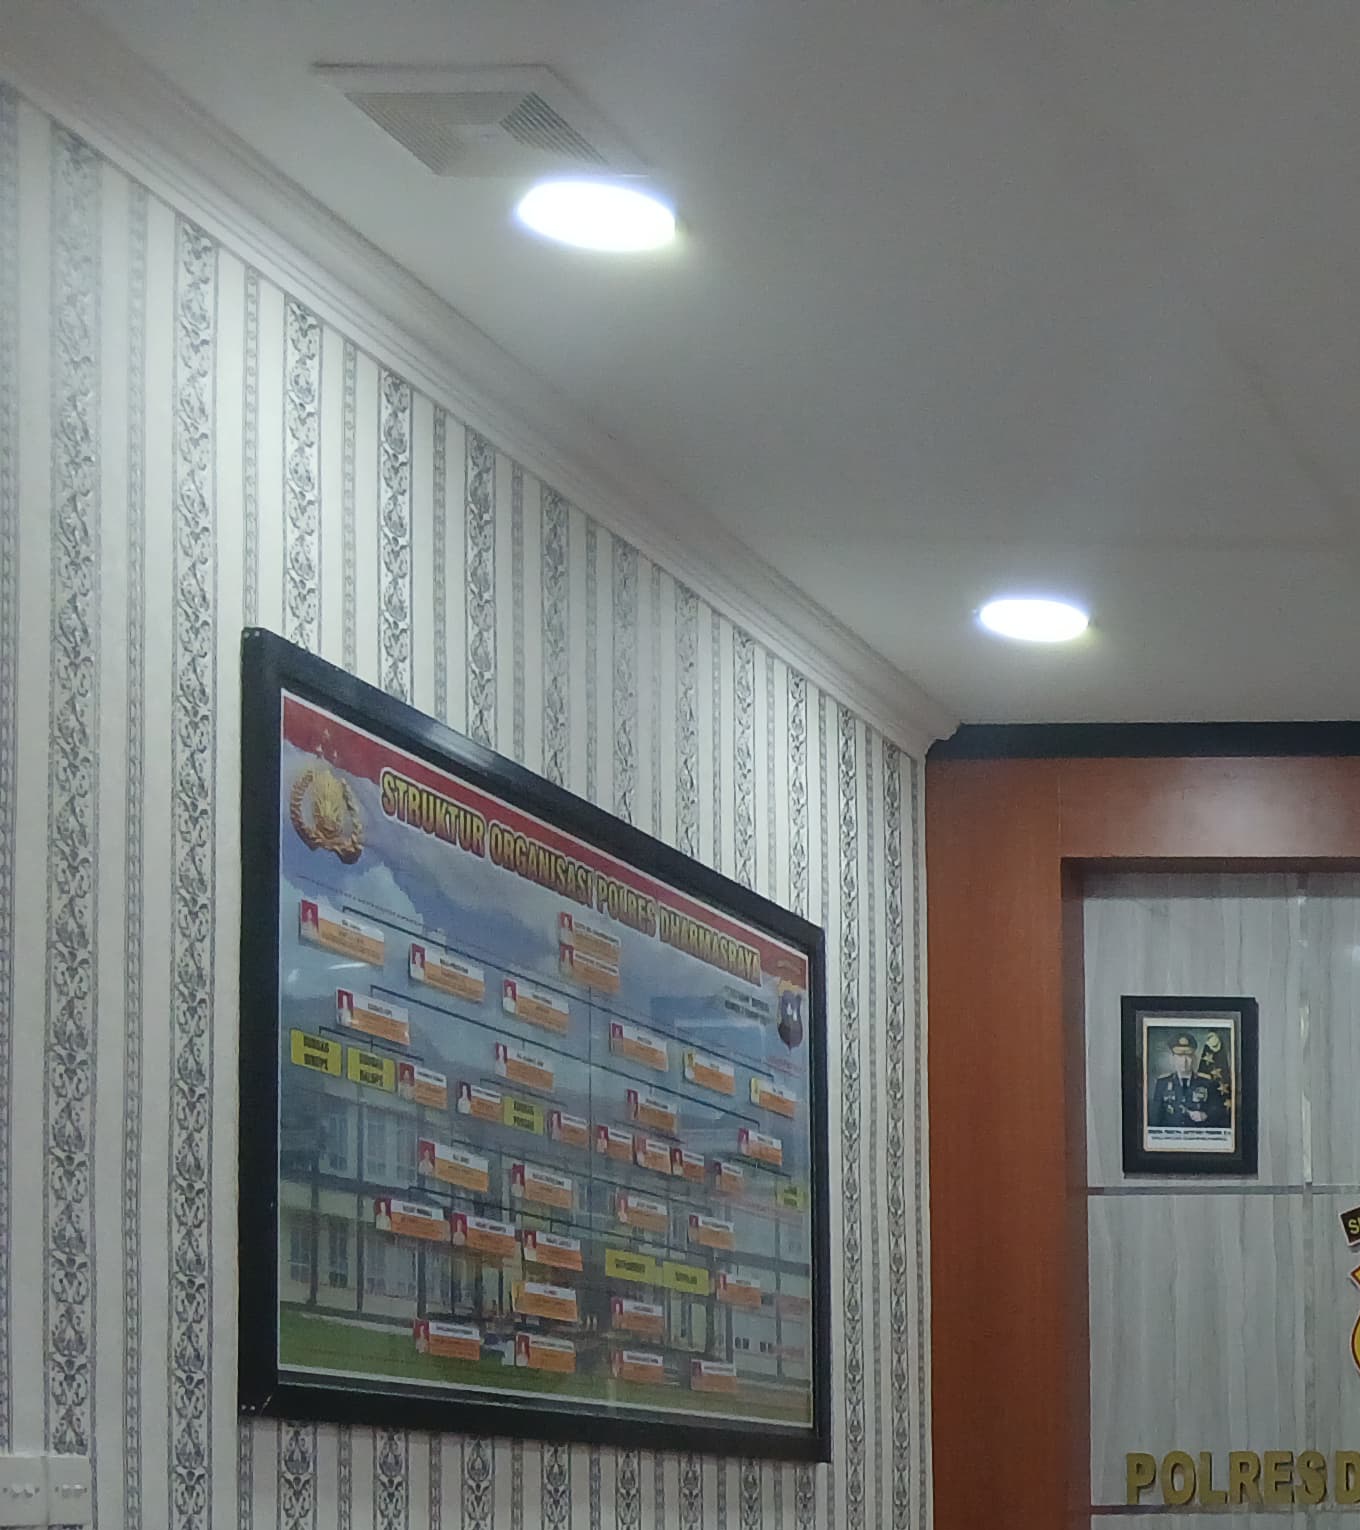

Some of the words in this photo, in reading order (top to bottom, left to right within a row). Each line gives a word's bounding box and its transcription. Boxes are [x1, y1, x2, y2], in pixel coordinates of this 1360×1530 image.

[381, 770, 486, 859] STRUKTUR
[489, 821, 595, 910] ORGANISASI
[596, 872, 657, 939] POLRES
[659, 905, 762, 987] DHARMASRAYA
[1126, 1451, 1328, 1505] POLRES
